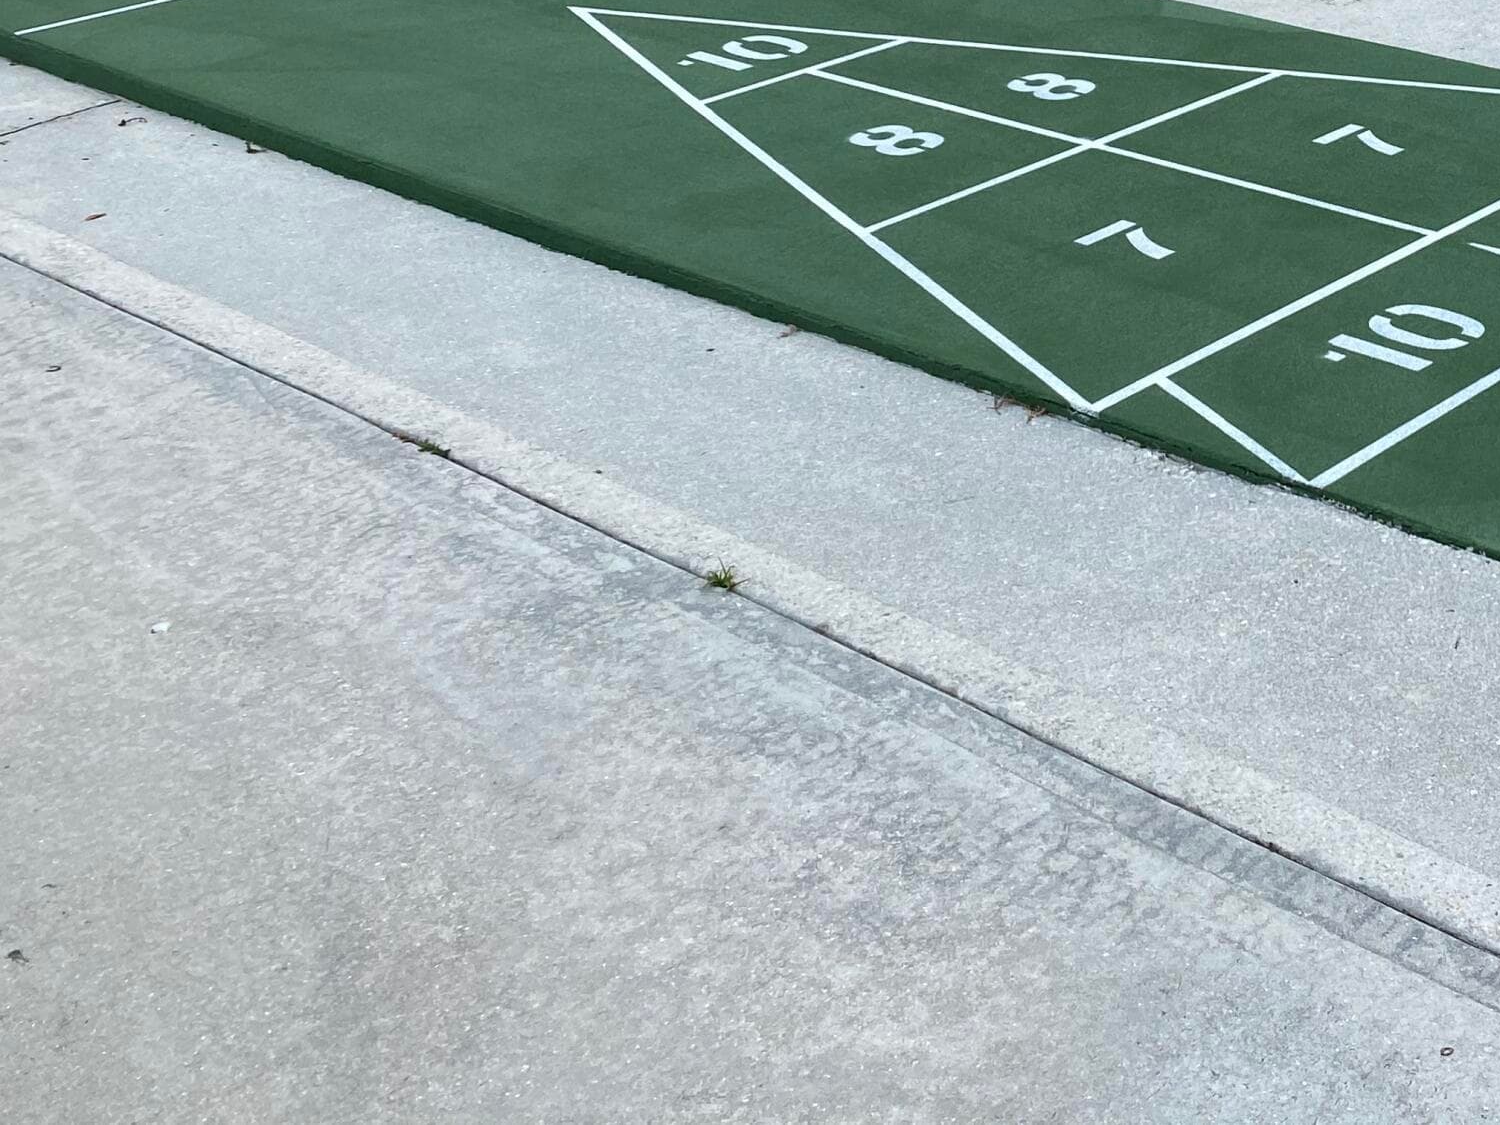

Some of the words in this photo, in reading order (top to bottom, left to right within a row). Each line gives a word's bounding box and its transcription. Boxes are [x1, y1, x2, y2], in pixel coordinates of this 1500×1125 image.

[677, 34, 809, 71] 10
[1006, 72, 1096, 101] 8
[848, 124, 945, 156] 8
[1312, 123, 1405, 156] 7
[1073, 219, 1176, 260] 7
[1323, 304, 1486, 372] 10
